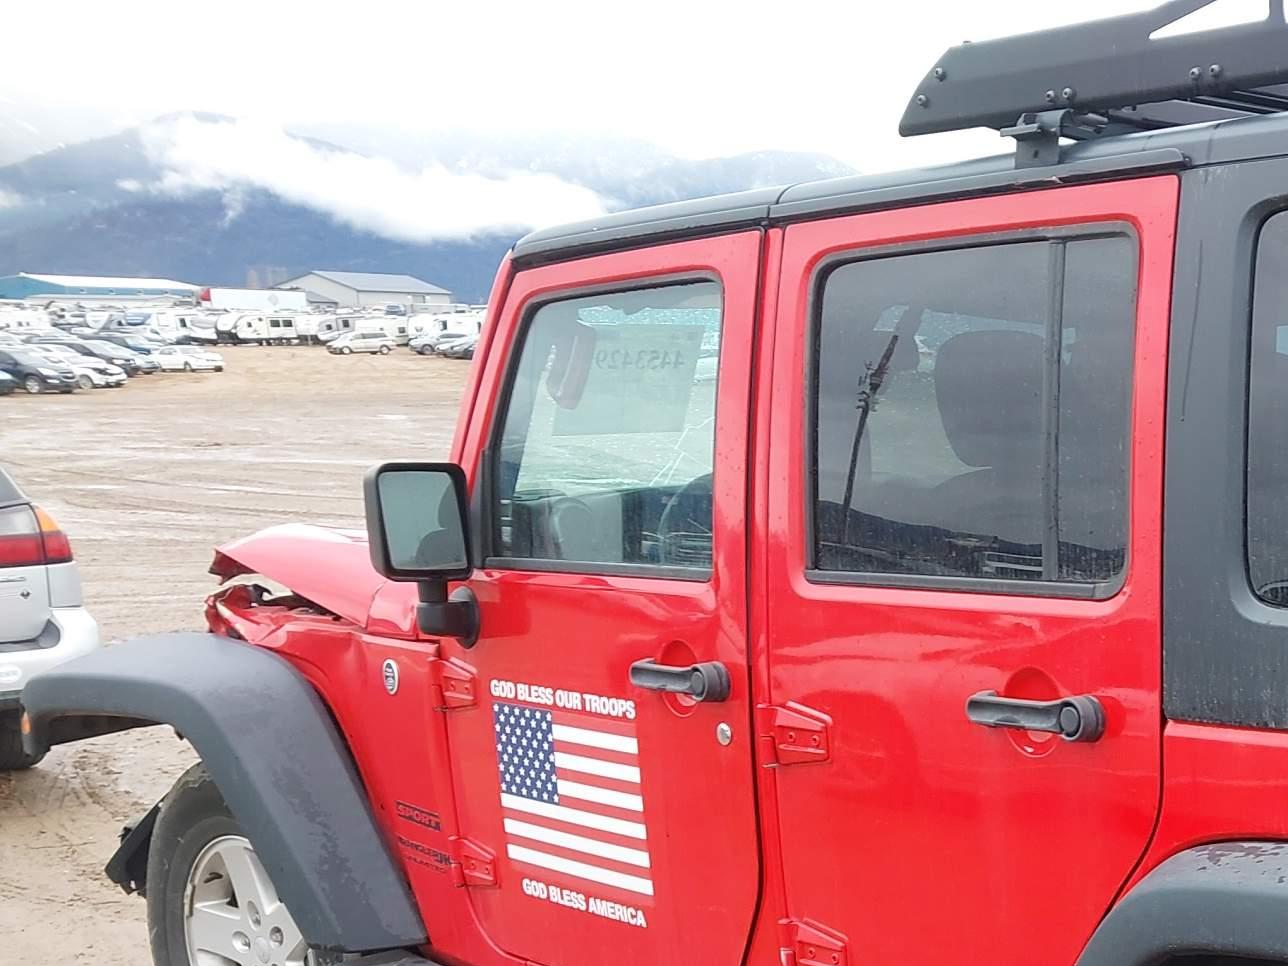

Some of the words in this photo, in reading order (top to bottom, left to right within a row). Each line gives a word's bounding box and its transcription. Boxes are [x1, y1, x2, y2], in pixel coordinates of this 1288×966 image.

[490, 679, 516, 698] GOD
[516, 684, 554, 705] BLESS
[555, 690, 582, 711] OUR
[584, 695, 637, 719] TROOPS
[397, 802, 440, 831] SPORT
[522, 878, 548, 900] GOD
[549, 886, 587, 911] BLESS
[588, 898, 647, 928] AMERICA
